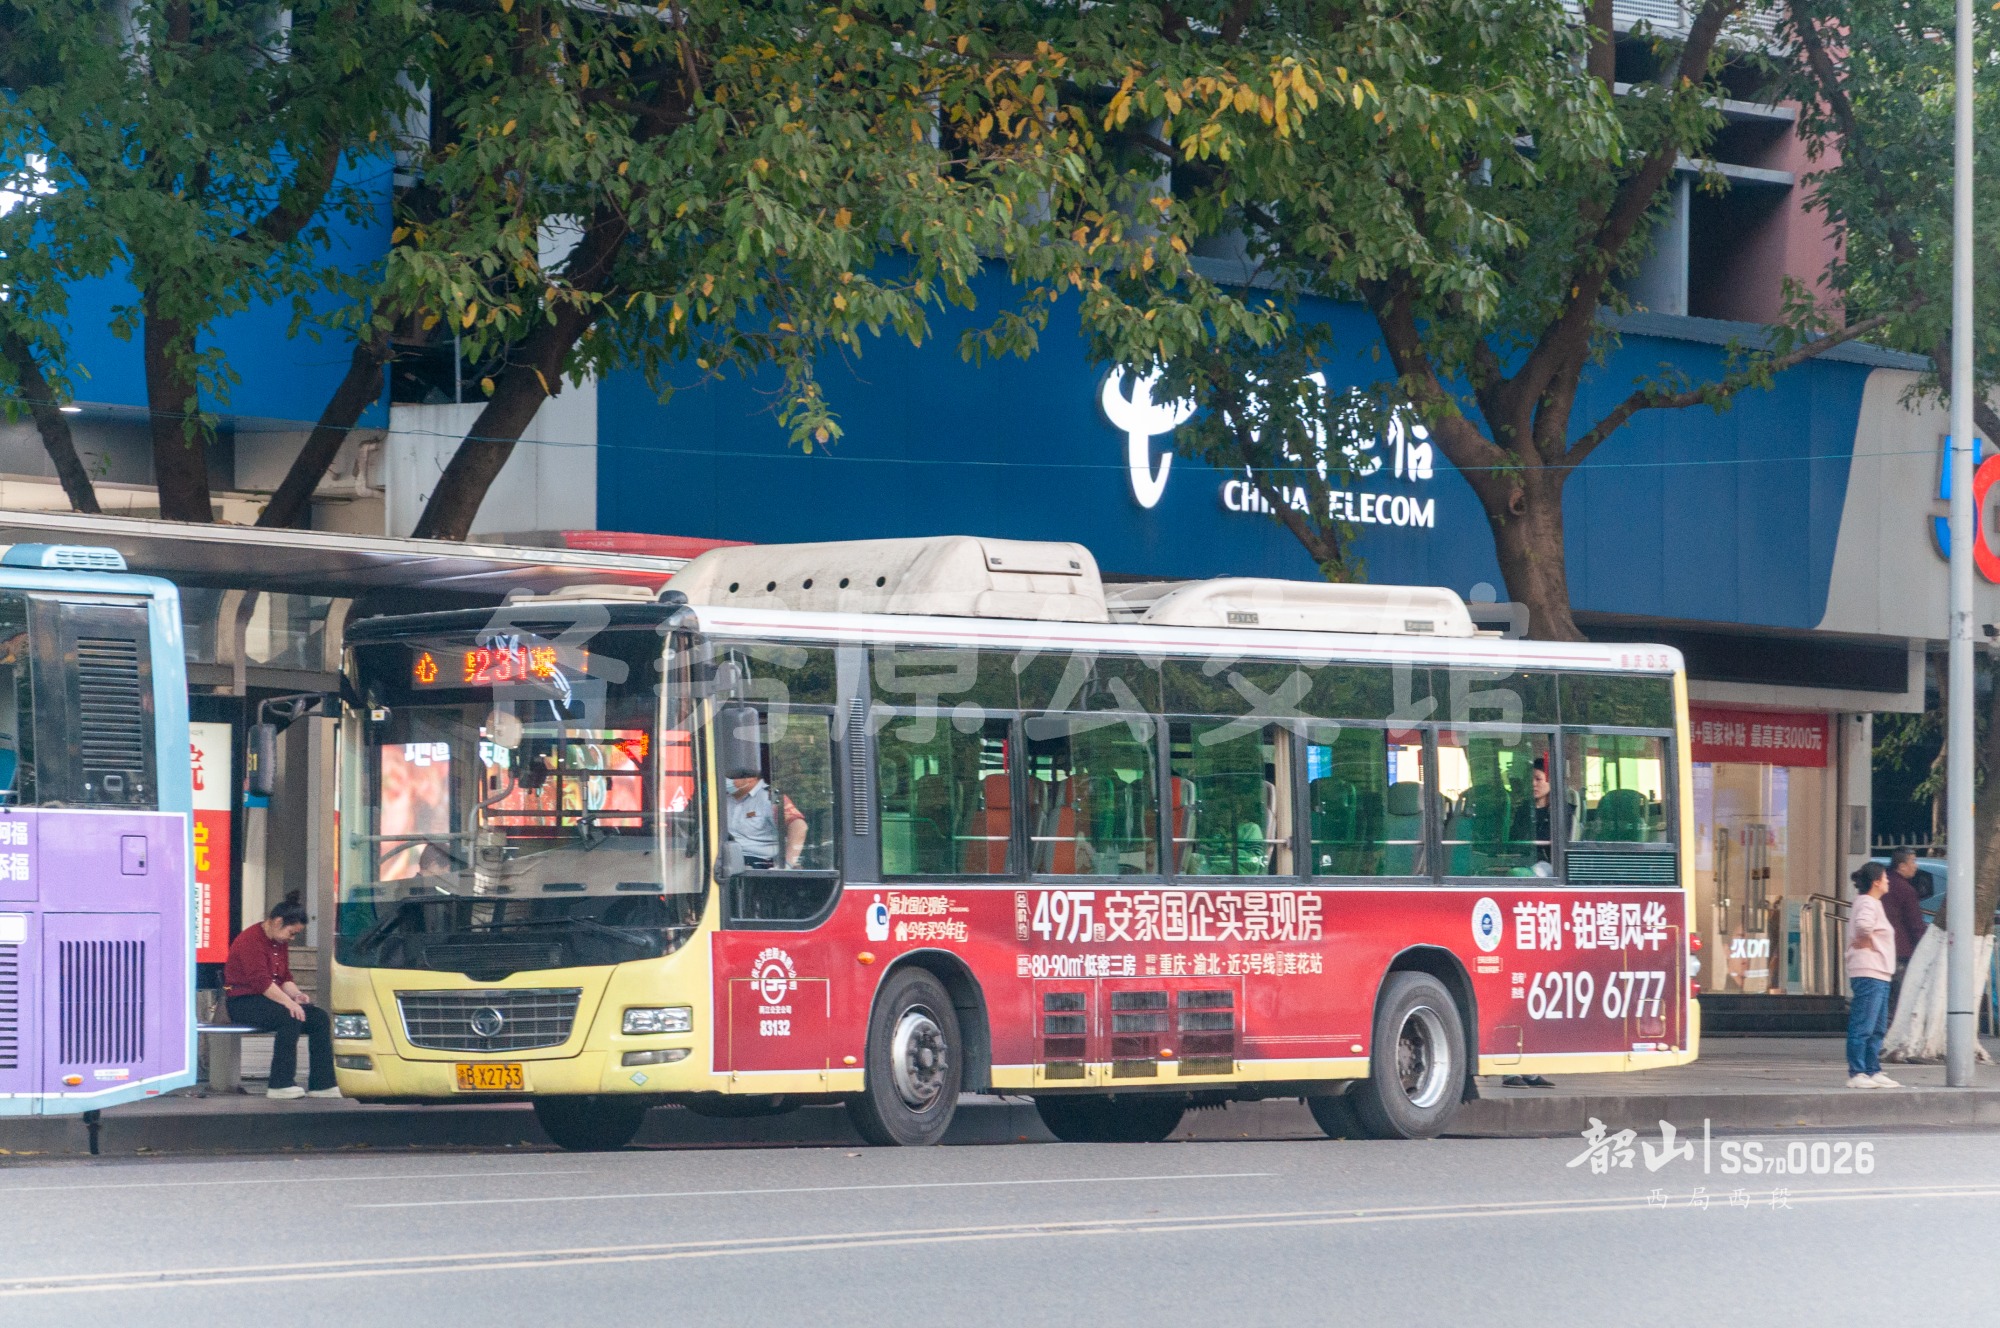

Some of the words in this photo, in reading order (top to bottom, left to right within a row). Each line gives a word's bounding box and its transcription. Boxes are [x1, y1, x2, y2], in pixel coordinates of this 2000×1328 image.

[1322, 489, 1435, 529] ELECOM
[1527, 971, 1595, 1020] 6219
[1602, 971, 1667, 1019] 6777
[759, 1019, 791, 1036] 83132
